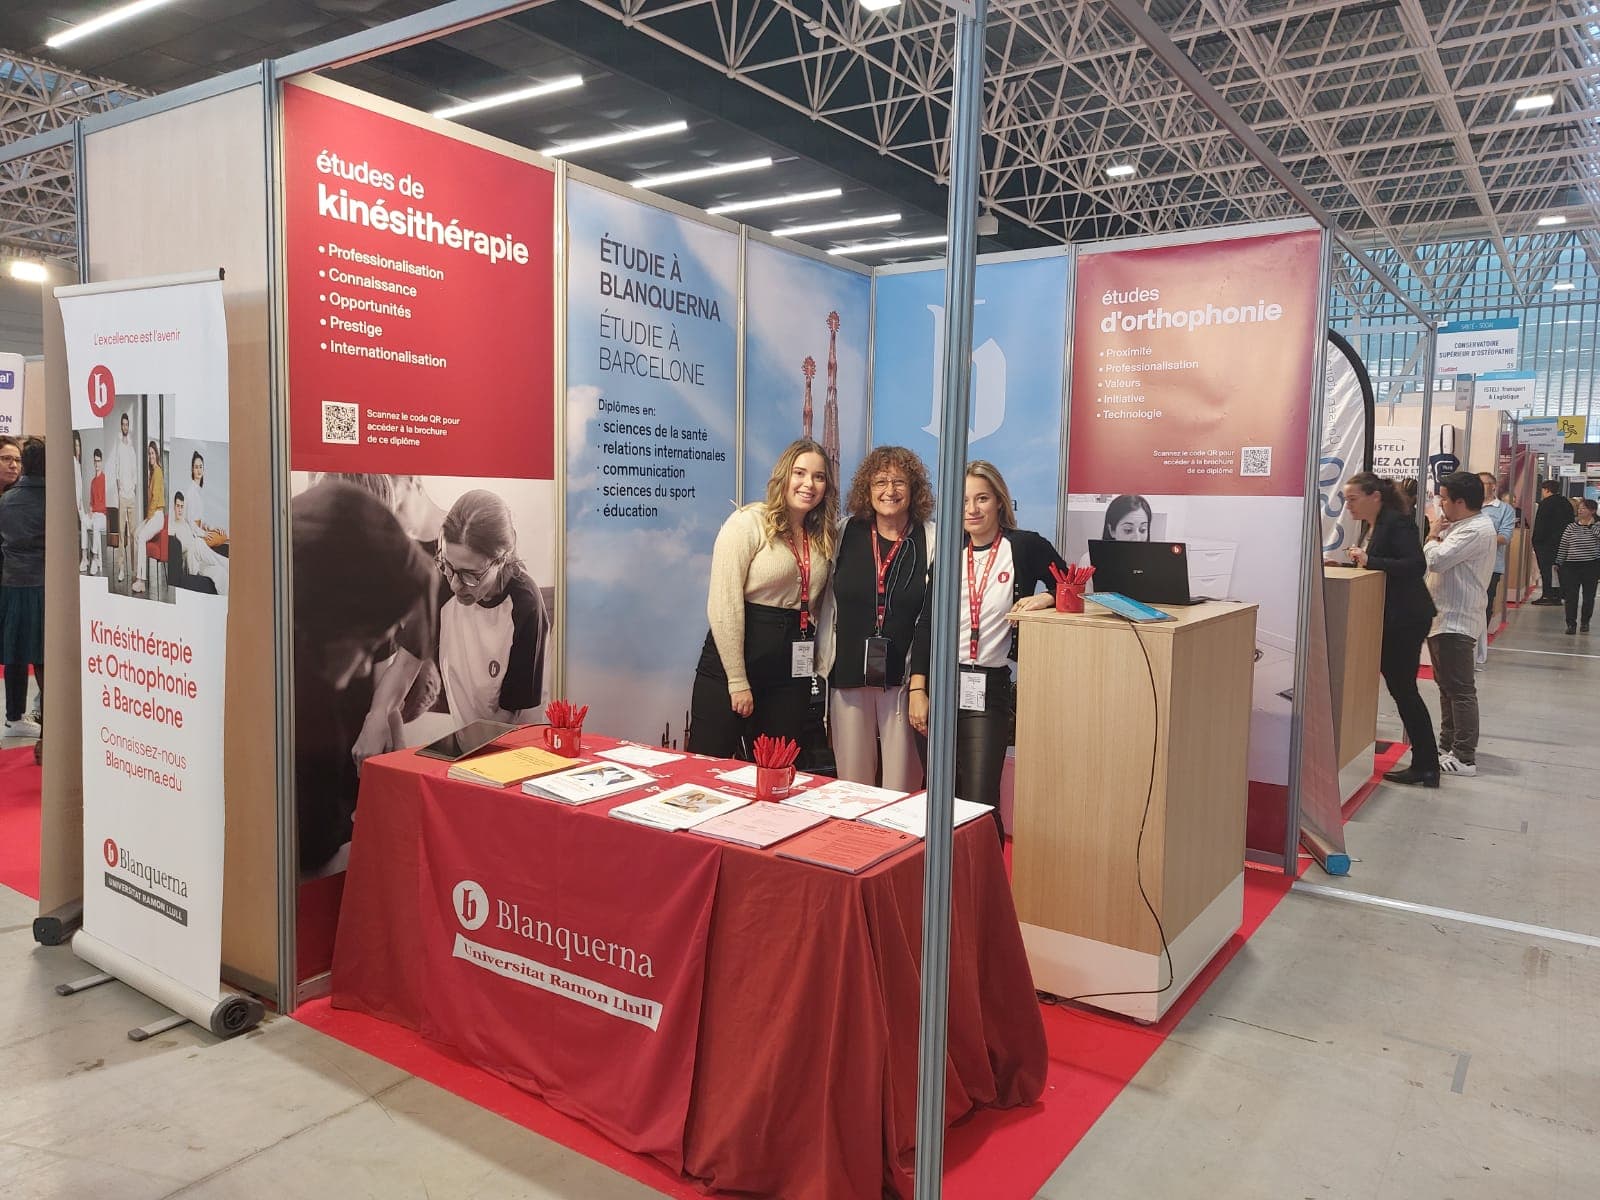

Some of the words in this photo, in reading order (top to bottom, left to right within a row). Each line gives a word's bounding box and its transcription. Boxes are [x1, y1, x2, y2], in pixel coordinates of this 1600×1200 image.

[316, 149, 394, 191] études
[398, 174, 424, 199] de
[318, 183, 529, 264] kinésithérapie
[328, 243, 444, 280] Professionalisation
[600, 232, 665, 278] ÉTUDIE
[670, 253, 682, 282] À
[329, 268, 417, 297] Connaissance
[329, 292, 411, 318] Opportunités
[600, 271, 720, 322] BLANQUERNA
[1102, 287, 1159, 305] études
[1101, 300, 1282, 332] d'orthophonie
[94, 332, 139, 346] L'excellence
[140, 331, 152, 343] est
[153, 329, 180, 342] l'avenir
[330, 316, 383, 338] Prestige
[600, 308, 663, 348] ÉTUDIE
[669, 323, 680, 352] À
[330, 340, 446, 367] Internationalisation
[1106, 346, 1152, 358] Proximité
[1454, 340, 1499, 349] CONSERVATOIRE
[600, 347, 705, 386] BARCELONE
[1105, 360, 1199, 373] Professionalisation
[1105, 378, 1141, 388] Valeurs
[598, 399, 640, 415] Diplômes
[643, 406, 656, 416] en:
[1104, 393, 1145, 404] Initiative
[367, 409, 400, 421] Scannez
[401, 412, 408, 421] le
[410, 413, 428, 422] code
[429, 414, 441, 424] QR
[442, 417, 460, 425] pour
[1103, 409, 1162, 420] Technologie
[367, 423, 399, 433] accéder
[400, 424, 404, 433] à
[406, 425, 413, 433] la
[414, 425, 447, 436] brochure
[603, 420, 651, 436] sciences
[655, 423, 667, 438] de
[670, 425, 679, 439] la
[681, 429, 708, 441] santé
[367, 435, 377, 443] de
[379, 436, 388, 444] ce
[390, 436, 420, 446] diplôme
[1374, 444, 1404, 452] ISTELI
[603, 441, 651, 456] relations
[654, 444, 726, 462] internationales
[1218, 450, 1234, 458] pour
[603, 464, 685, 479] communication
[1206, 467, 1233, 475] diplôme
[603, 483, 651, 497] sciences
[655, 484, 667, 498] du
[670, 486, 696, 500] sport
[603, 504, 658, 517] éducation
[90, 620, 192, 665] Kinésithérapie
[88, 655, 103, 675] et
[106, 654, 197, 699] Orthophonie
[102, 685, 111, 708] à
[114, 687, 183, 728] Barcelone
[101, 727, 187, 770] Connaissez-nous
[106, 750, 182, 791] Blanquerna.edu
[120, 847, 188, 898] Blanquerna
[142, 894, 165, 912] RAMON
[496, 899, 655, 979] Blanquerna
[464, 942, 545, 982] Universitat
[550, 973, 608, 1005] Ramon
[613, 996, 653, 1019] Llull
